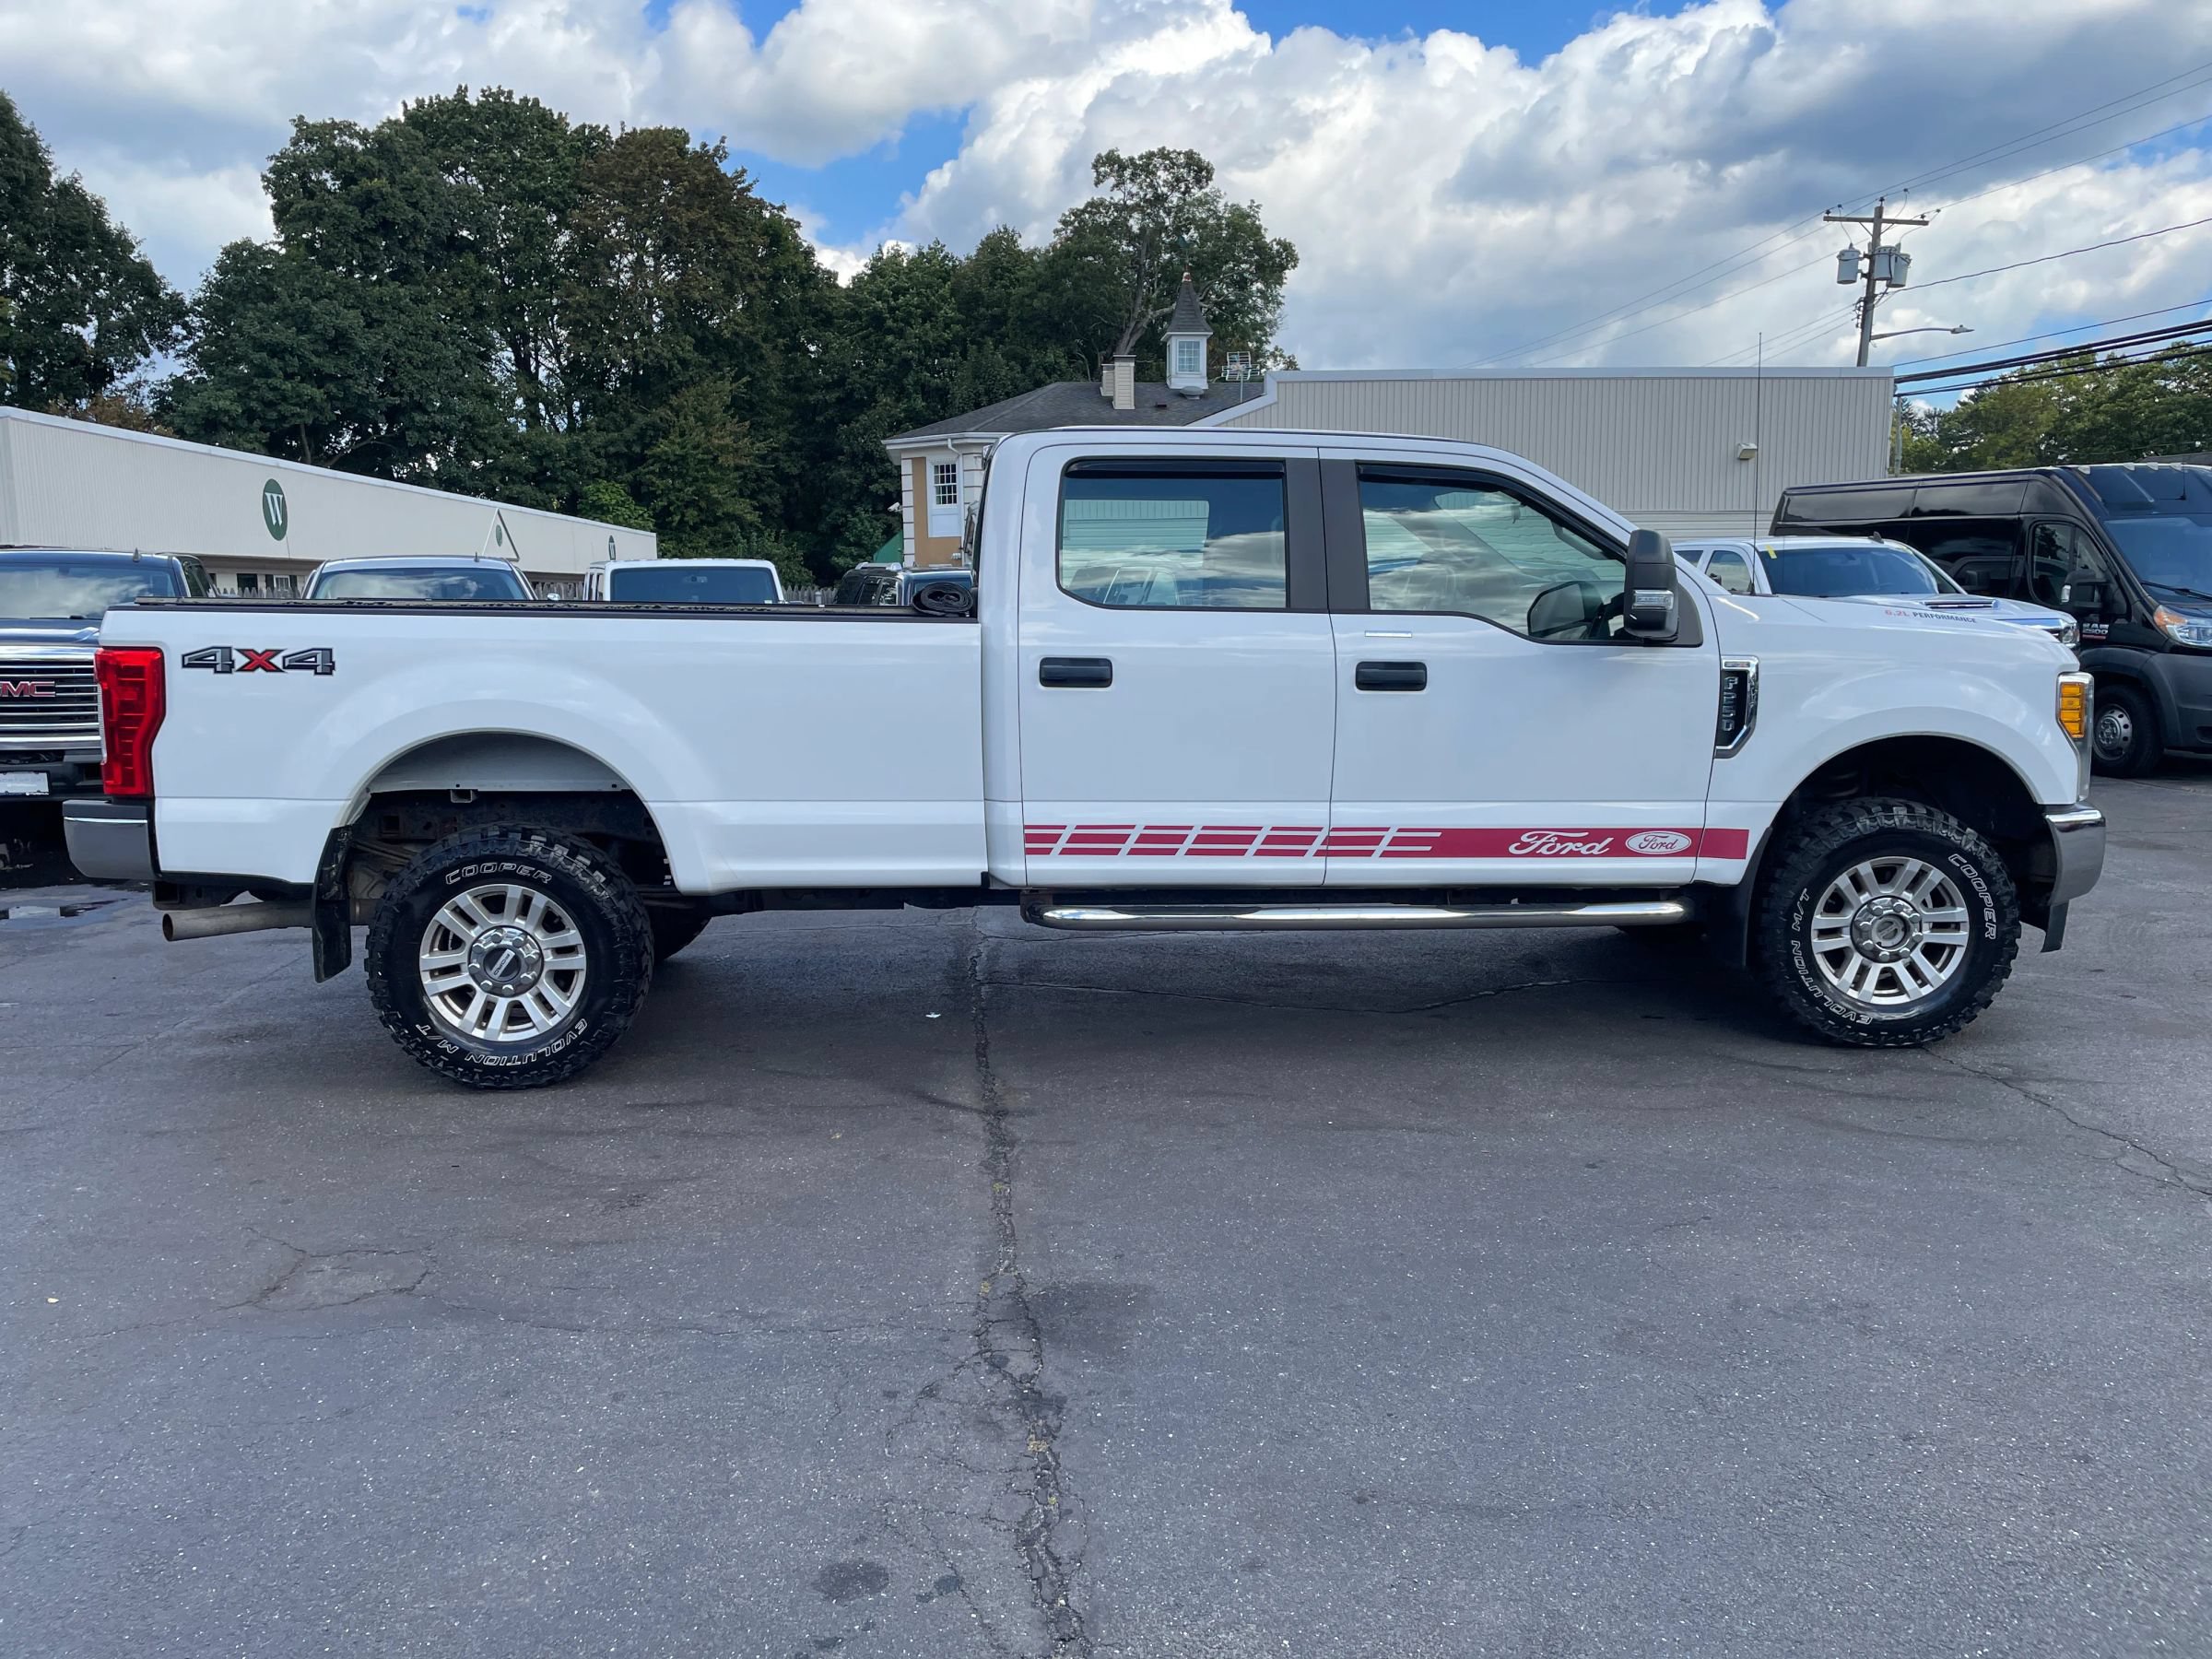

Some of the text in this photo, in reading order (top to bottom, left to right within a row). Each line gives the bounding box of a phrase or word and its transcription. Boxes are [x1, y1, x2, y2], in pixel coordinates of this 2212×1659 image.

[265, 492, 283, 526] W
[1884, 609, 1977, 624] 6.2L PERFORMANCE
[0, 681, 55, 698] MC
[1508, 830, 1614, 855] Ford
[1638, 834, 1677, 851] Ford
[445, 862, 553, 885] COOPER
[1947, 853, 1996, 940] COOPER
[493, 953, 511, 976] FORD
[1791, 888, 1873, 1025] EVOLUTION M/T
[415, 1018, 589, 1066] EVOLUTION M/T
